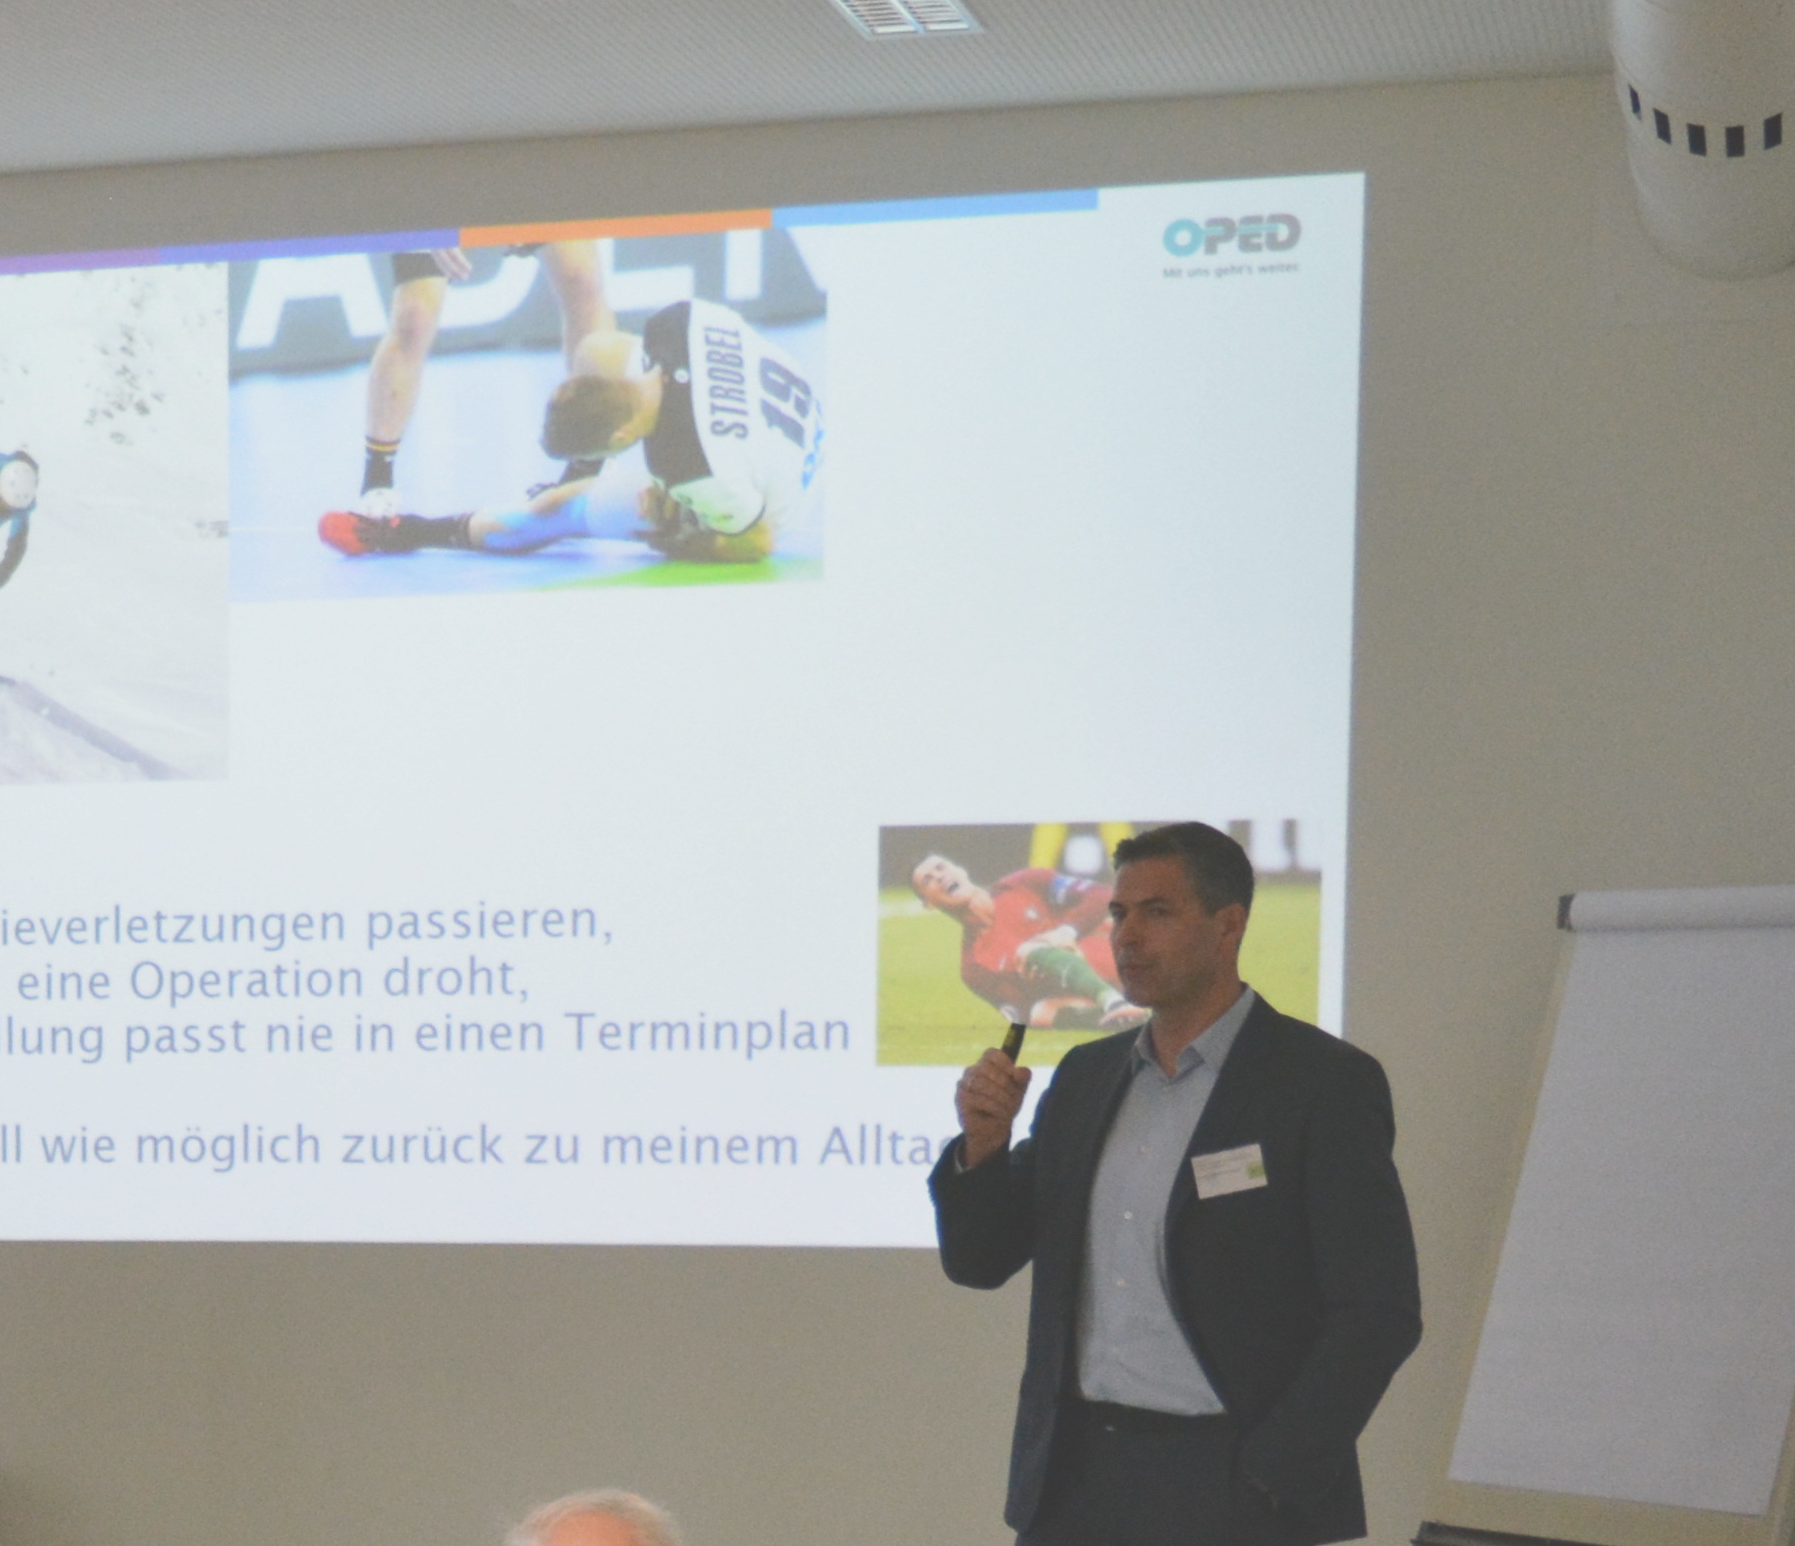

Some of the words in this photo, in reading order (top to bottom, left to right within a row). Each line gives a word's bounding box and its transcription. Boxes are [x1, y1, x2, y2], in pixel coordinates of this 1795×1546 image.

[1163, 213, 1302, 258] OPED
[1163, 267, 1183, 279] Mit
[1187, 266, 1211, 278] uns
[704, 326, 750, 440] STROBEL
[760, 357, 812, 449] 19
[367, 902, 612, 951] passieren,
[17, 963, 111, 1001] eine
[130, 960, 363, 1011] Operation
[383, 957, 530, 1004] droht,
[125, 1014, 246, 1064] passt
[266, 1015, 334, 1053] nie
[355, 1014, 394, 1052] in
[415, 1013, 544, 1052] einen
[564, 1008, 850, 1061] Terminplan
[40, 1126, 116, 1164] wie
[137, 1123, 321, 1174] möglich
[341, 1123, 503, 1164] zurück
[524, 1134, 580, 1165] zu
[603, 1126, 798, 1166] meinem
[819, 1123, 954, 1167] Allta
